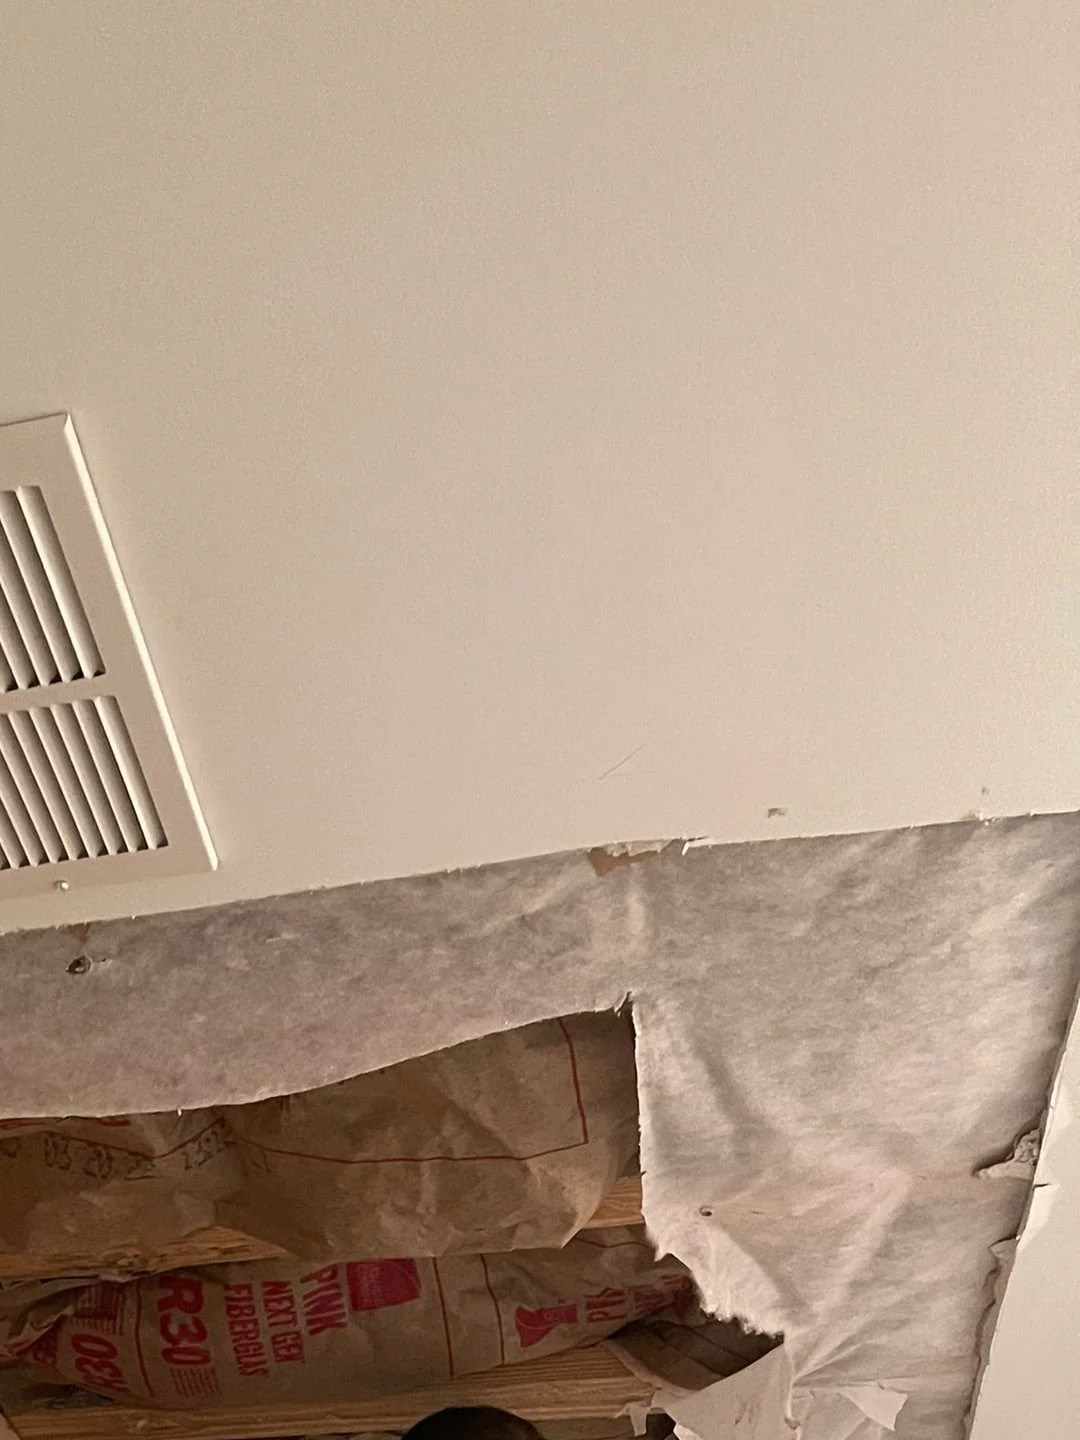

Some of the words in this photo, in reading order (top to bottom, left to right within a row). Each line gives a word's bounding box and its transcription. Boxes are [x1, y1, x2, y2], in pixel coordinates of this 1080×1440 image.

[157, 1277, 212, 1366] R30
[224, 1283, 270, 1377] FIBERGLAS
[261, 1280, 299, 1328] NEXT
[300, 1264, 347, 1336] PINK
